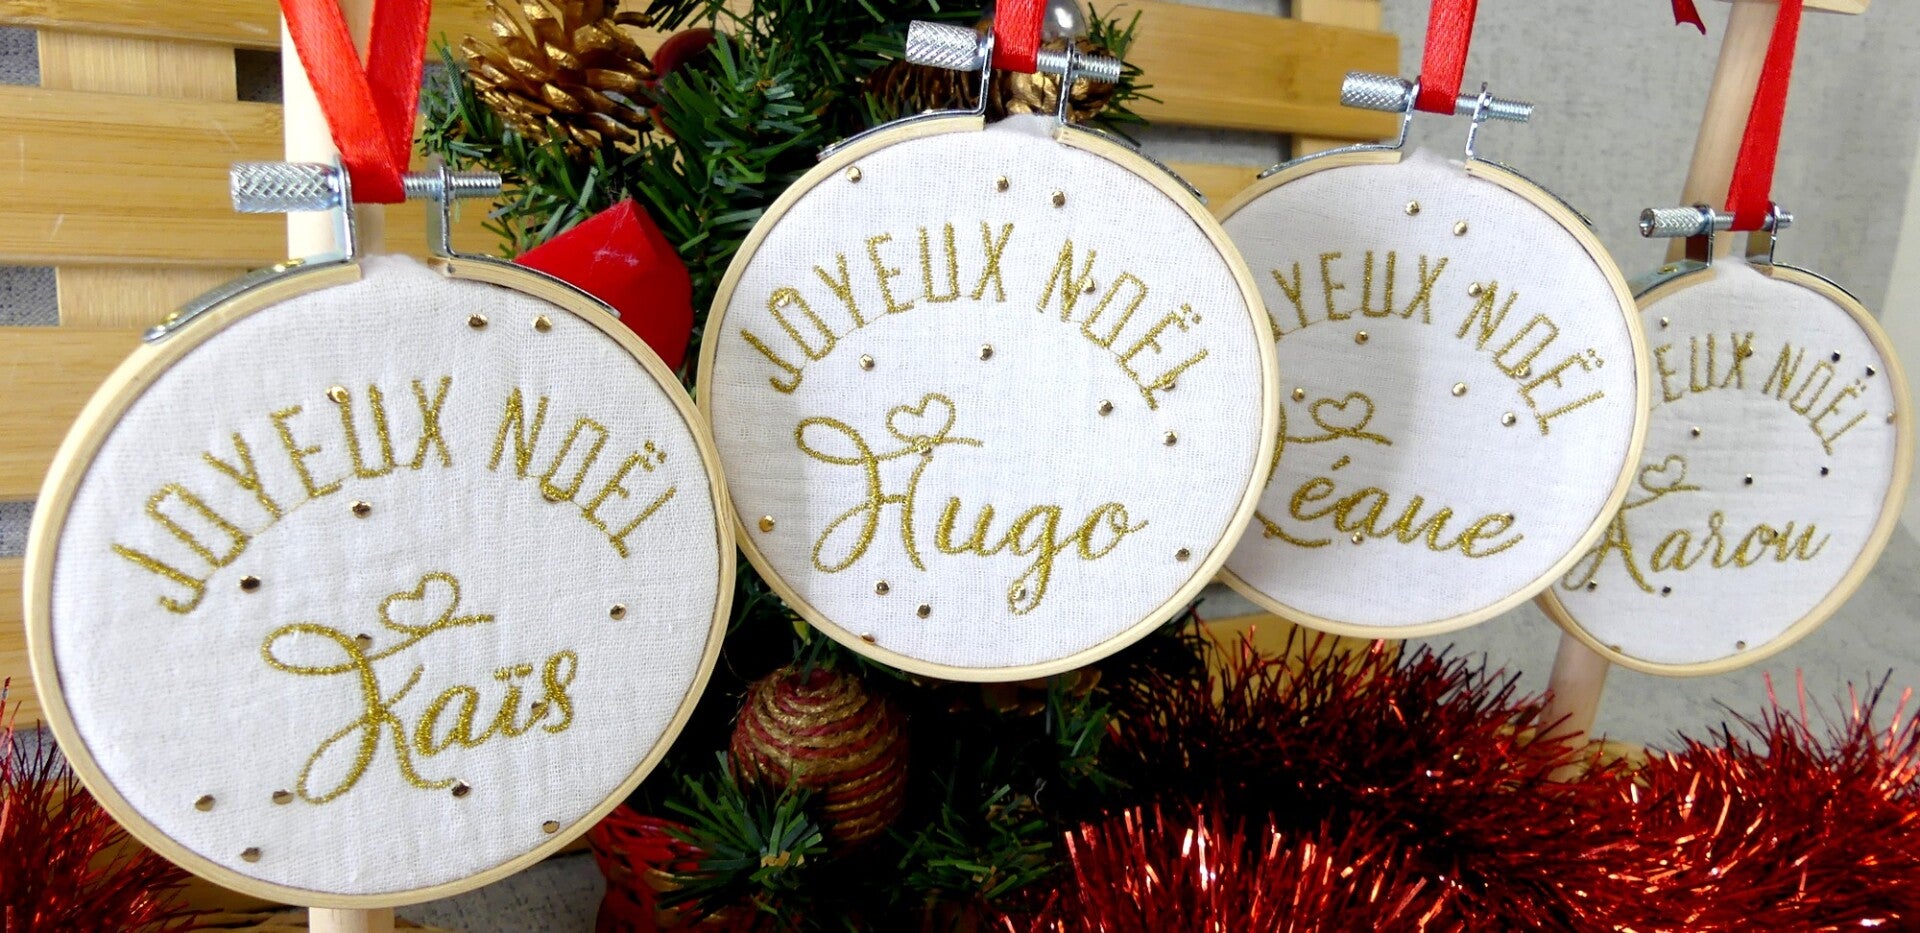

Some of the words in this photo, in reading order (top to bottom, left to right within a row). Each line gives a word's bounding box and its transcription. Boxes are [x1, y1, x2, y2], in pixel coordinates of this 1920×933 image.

[741, 222, 1015, 394] JOYEUX
[1036, 239, 1209, 410] NOËL
[1268, 251, 1449, 342] YEUX
[1456, 281, 1604, 435] NOËL
[1654, 330, 1755, 403] EUX
[1762, 342, 1868, 455] NOËL
[111, 376, 452, 614] JOYEUX
[489, 387, 676, 557] NOËL
[795, 417, 1149, 616] Hugo
[261, 622, 577, 804] Kaïs
